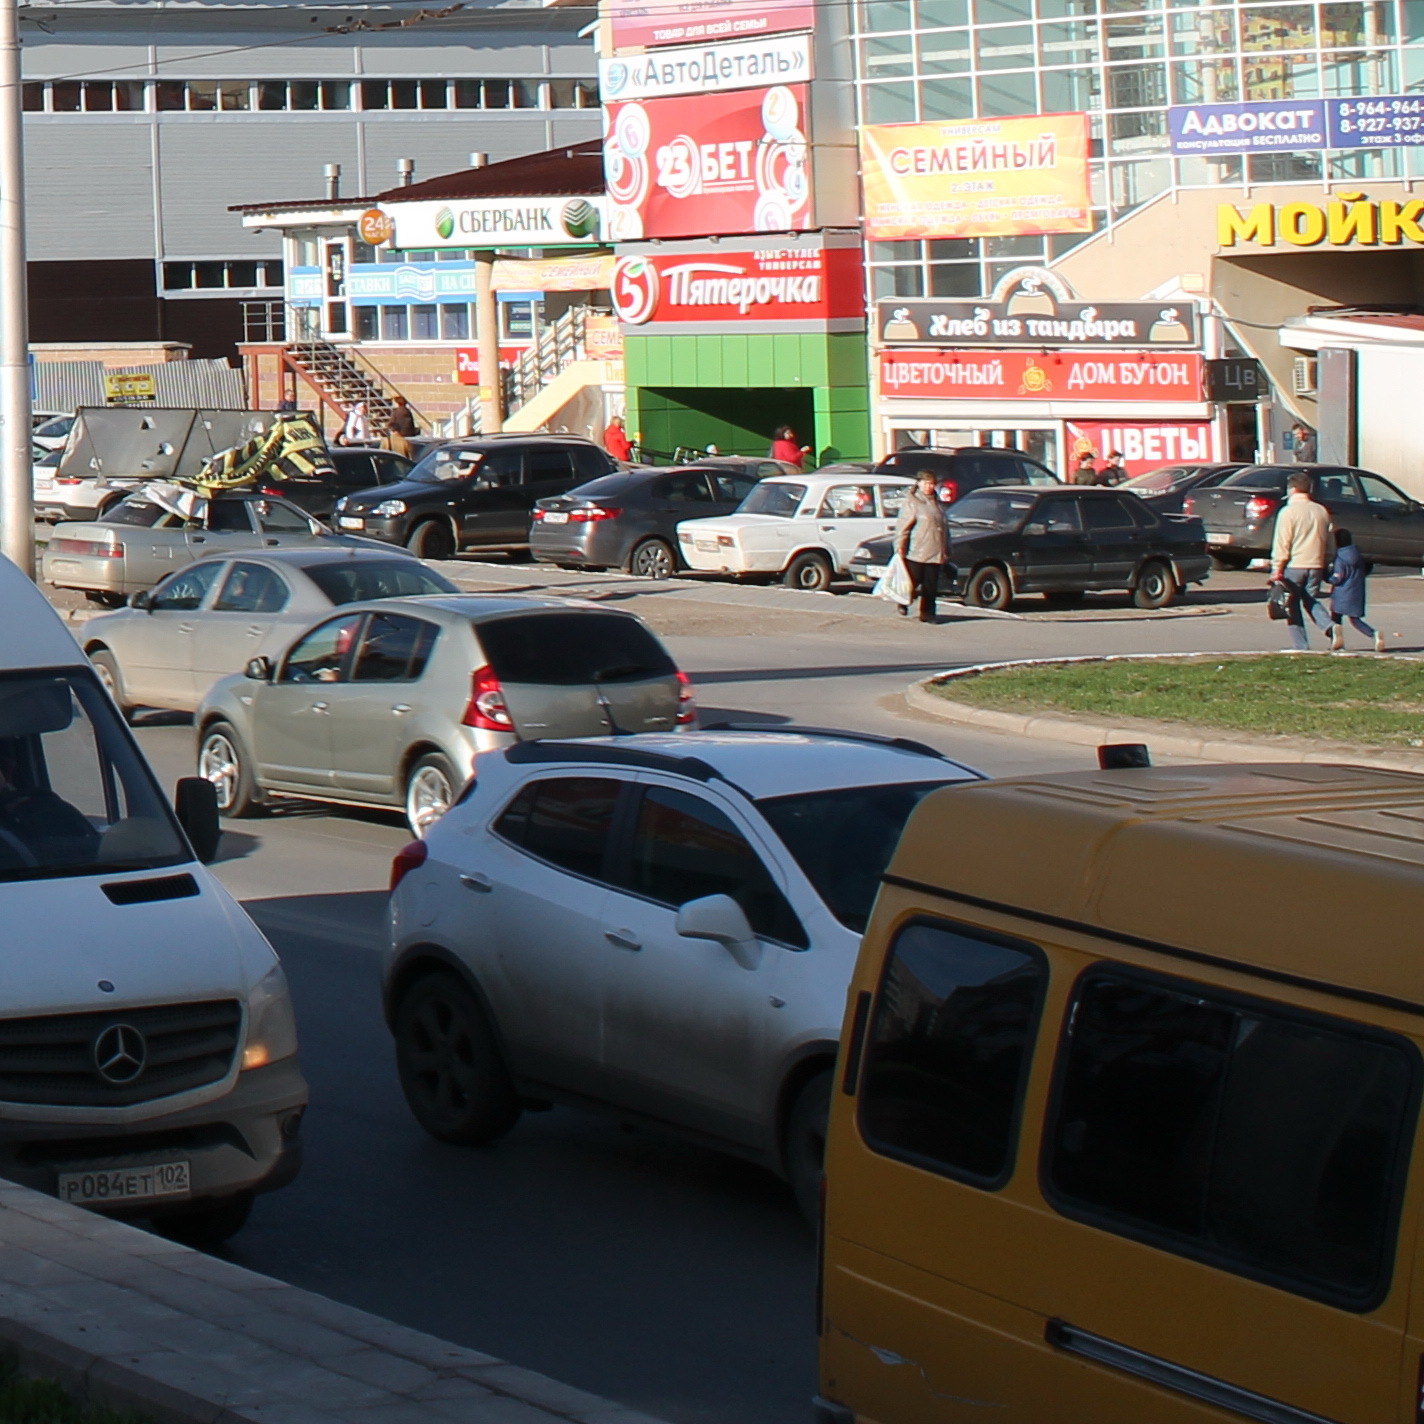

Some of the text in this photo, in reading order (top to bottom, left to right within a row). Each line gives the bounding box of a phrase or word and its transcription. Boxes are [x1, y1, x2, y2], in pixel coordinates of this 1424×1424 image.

[653, 17, 768, 40] ТОВАР ДЛЯ ВСЕЙ СЕМЬИ
[632, 50, 805, 88] «АвтоДеталь»
[941, 124, 1002, 136] УНИВЕРСАМ
[1176, 133, 1321, 150] консультация БЕСПЛАТНО
[1360, 133, 1402, 144] этаж 3
[890, 135, 1056, 175] СЕМЕЙНЫЙ
[364, 217, 383, 231] 24
[459, 207, 553, 233] СБЕРБАНК
[759, 260, 822, 270] УНИВЕРСАМ
[661, 263, 821, 314] Пятерочка
[929, 307, 1136, 340] Хлеб из тандыра
[884, 359, 1189, 387] ЦВЕТОЧНЫЙ ДОМ БУТОН
[1101, 427, 1207, 461] ЦВЕТЫ
[156, 1165, 185, 1184] 102
